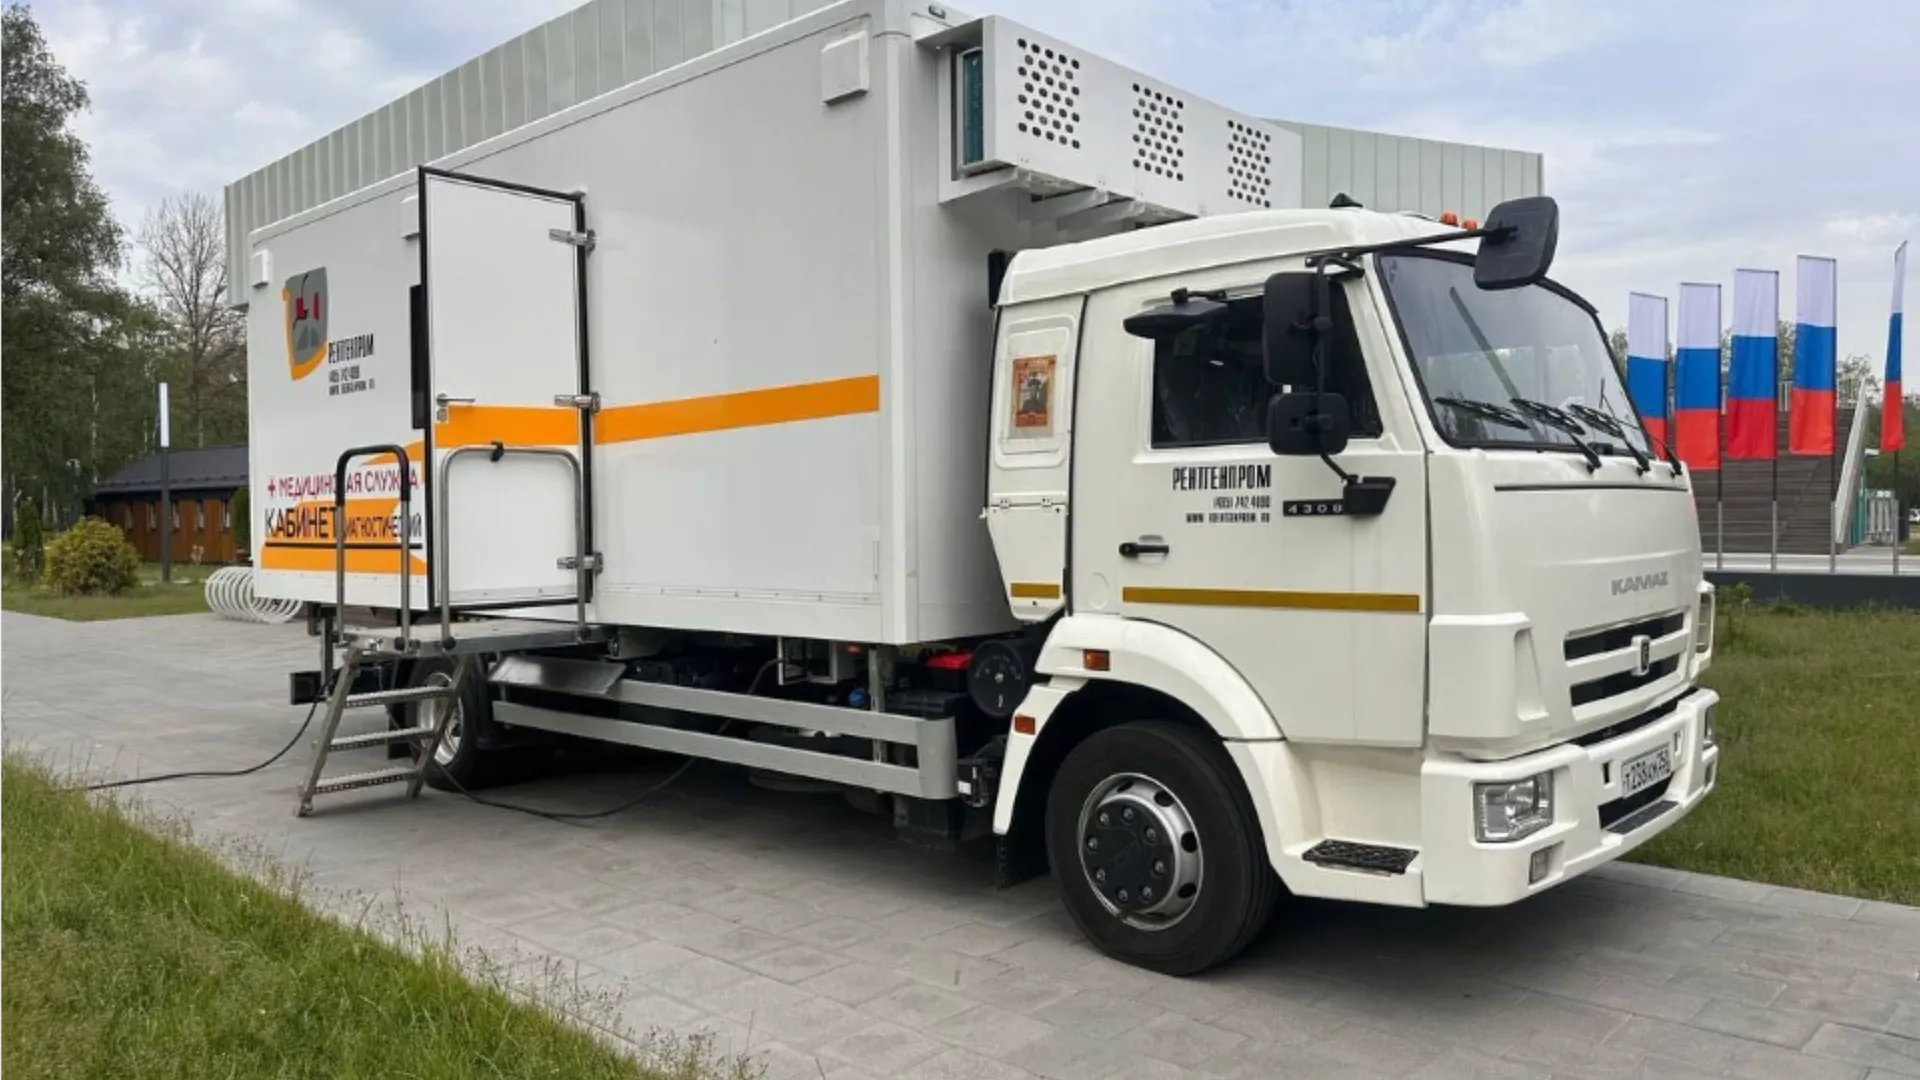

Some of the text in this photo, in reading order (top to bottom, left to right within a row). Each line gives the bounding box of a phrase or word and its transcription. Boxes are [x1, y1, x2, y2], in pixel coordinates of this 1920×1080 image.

[279, 468, 419, 497] МЕДИЦИНСАЯ СЛУЖА
[1288, 503, 1343, 514] 4308
[264, 506, 338, 538] КАБИНЕТ
[1611, 571, 1668, 595] KAMAZ
